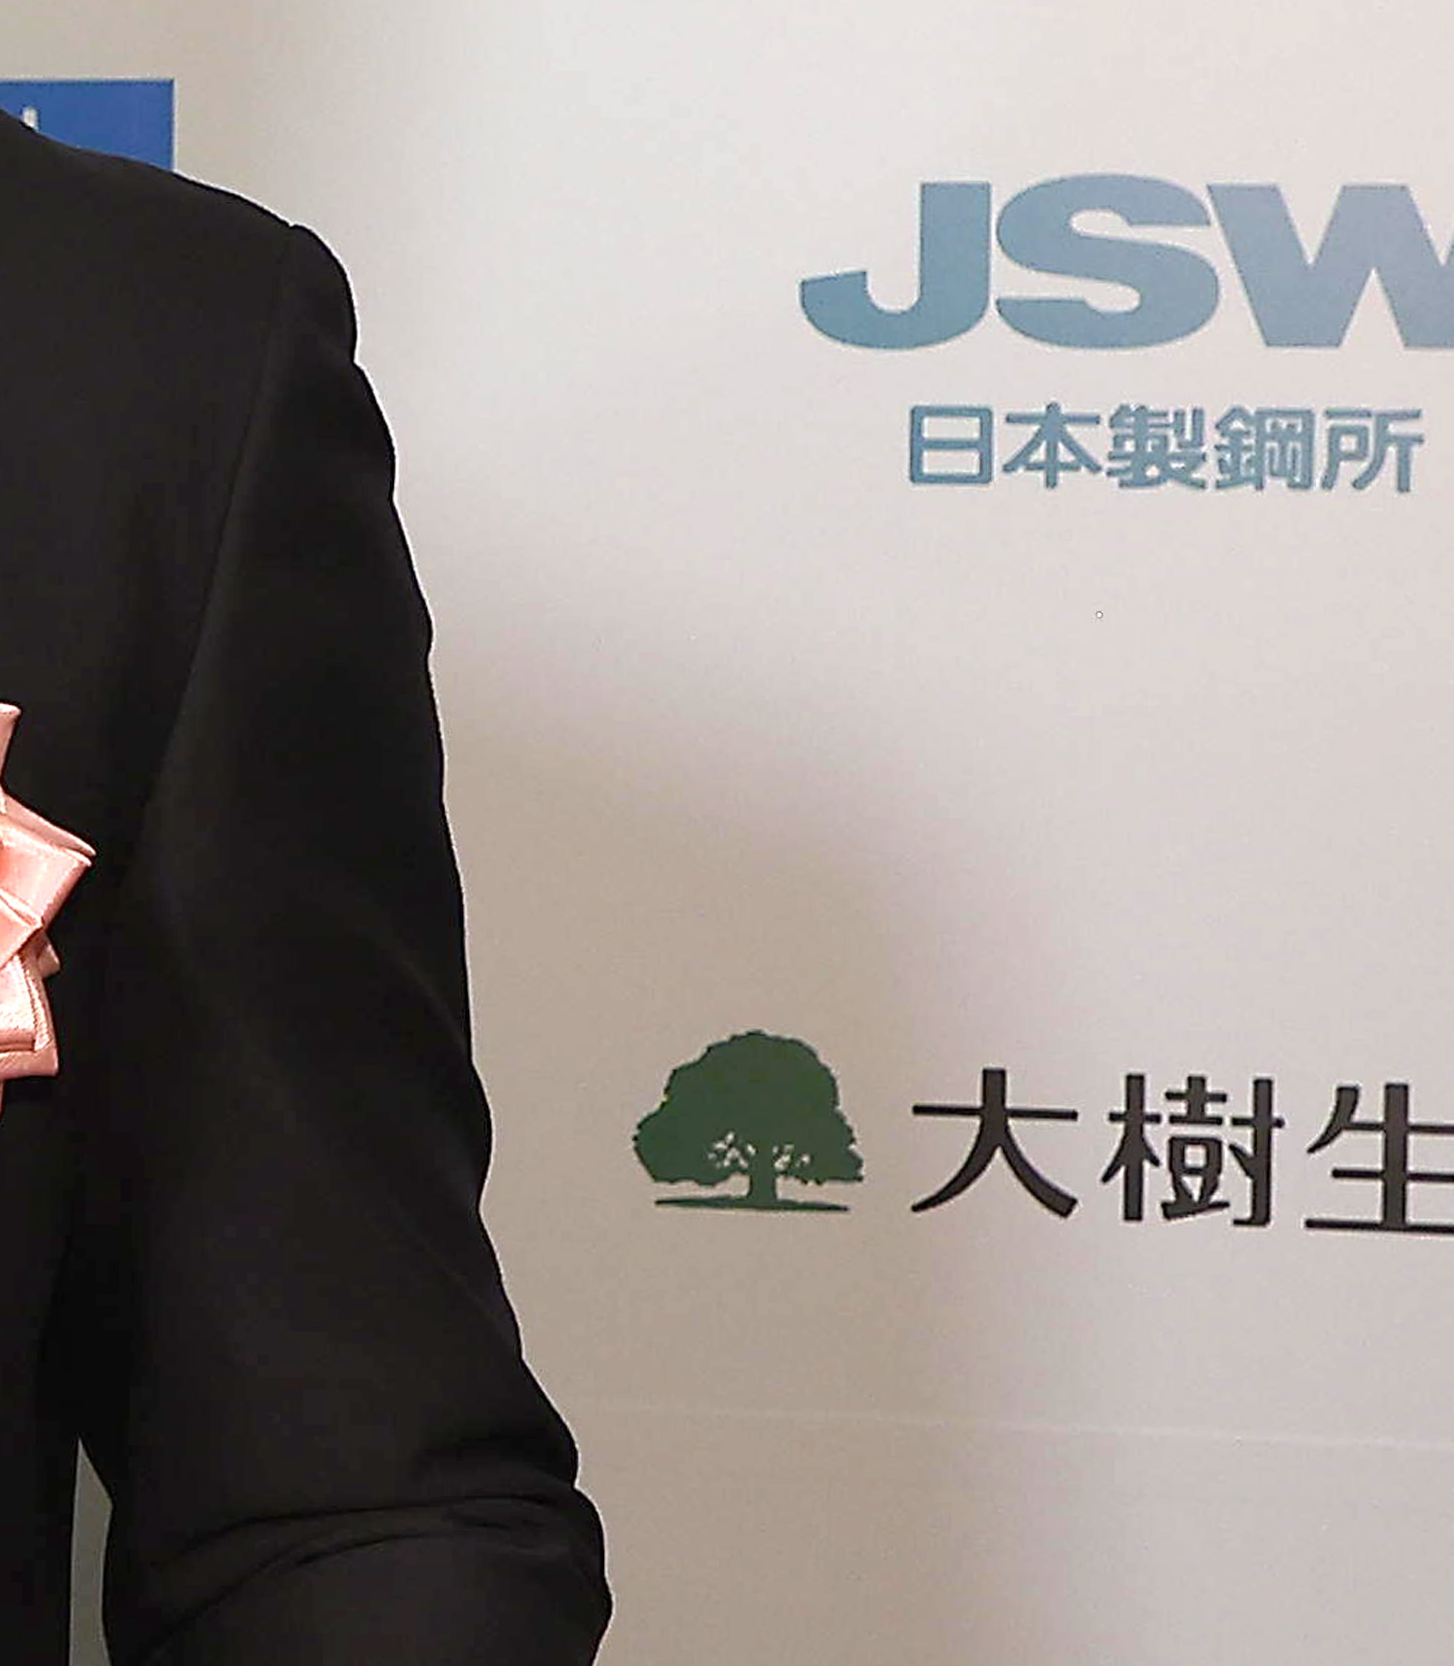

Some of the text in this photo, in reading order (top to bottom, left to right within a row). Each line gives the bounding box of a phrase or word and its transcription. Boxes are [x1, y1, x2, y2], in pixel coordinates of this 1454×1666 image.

[909, 400, 1426, 494] 日本製鋼所
